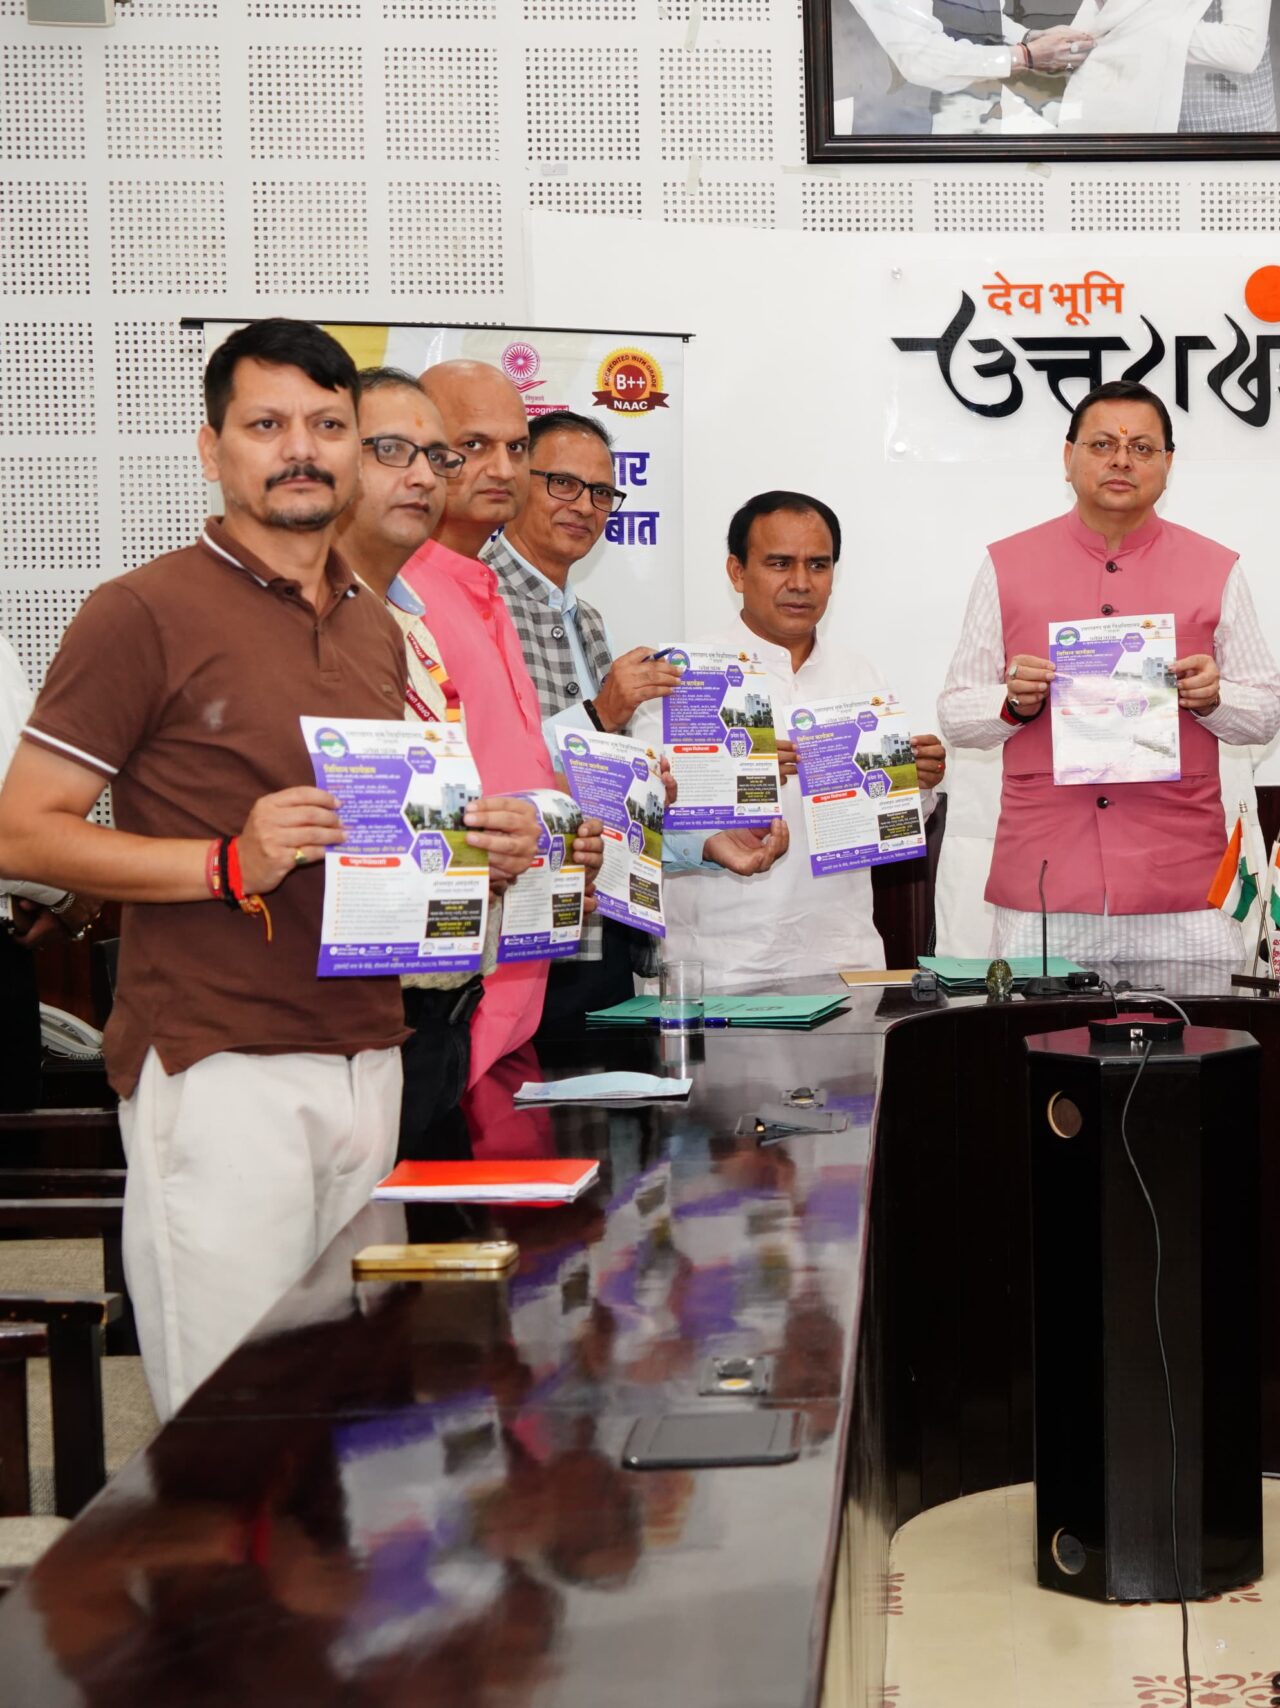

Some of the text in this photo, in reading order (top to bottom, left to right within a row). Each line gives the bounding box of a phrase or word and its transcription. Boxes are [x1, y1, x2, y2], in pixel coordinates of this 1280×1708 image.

[604, 354, 656, 388] ACCREDITED WITH GRADE
[616, 374, 646, 390] B++
[614, 400, 648, 410] NAAC
